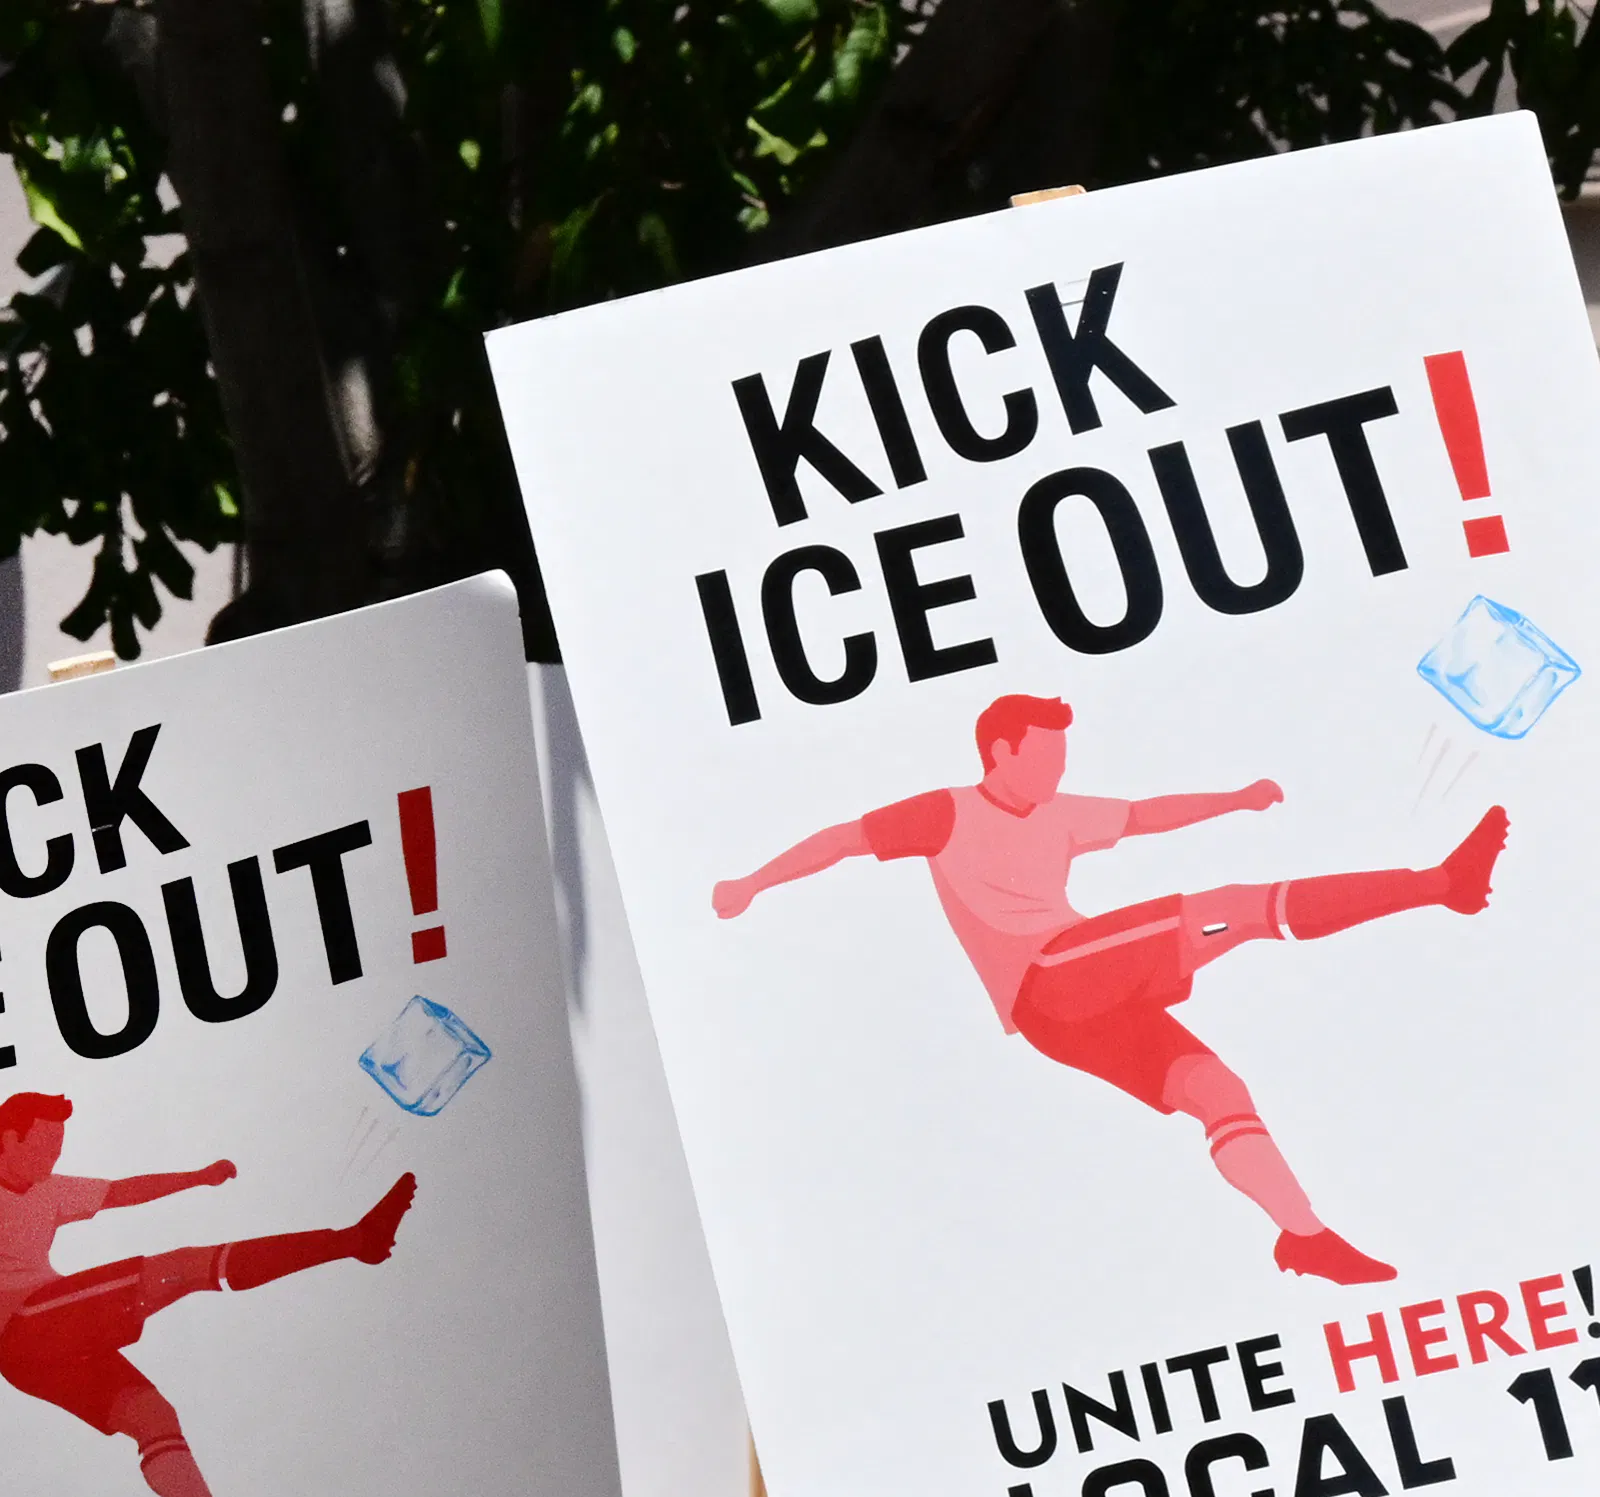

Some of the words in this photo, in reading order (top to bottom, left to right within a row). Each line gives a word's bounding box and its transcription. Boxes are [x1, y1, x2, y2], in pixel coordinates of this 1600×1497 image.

[732, 263, 1175, 527] KICK
[696, 514, 997, 726] ICE
[1018, 351, 1510, 654] OUT!
[46, 787, 446, 1059] OUT!
[988, 1334, 1295, 1468] UNITE
